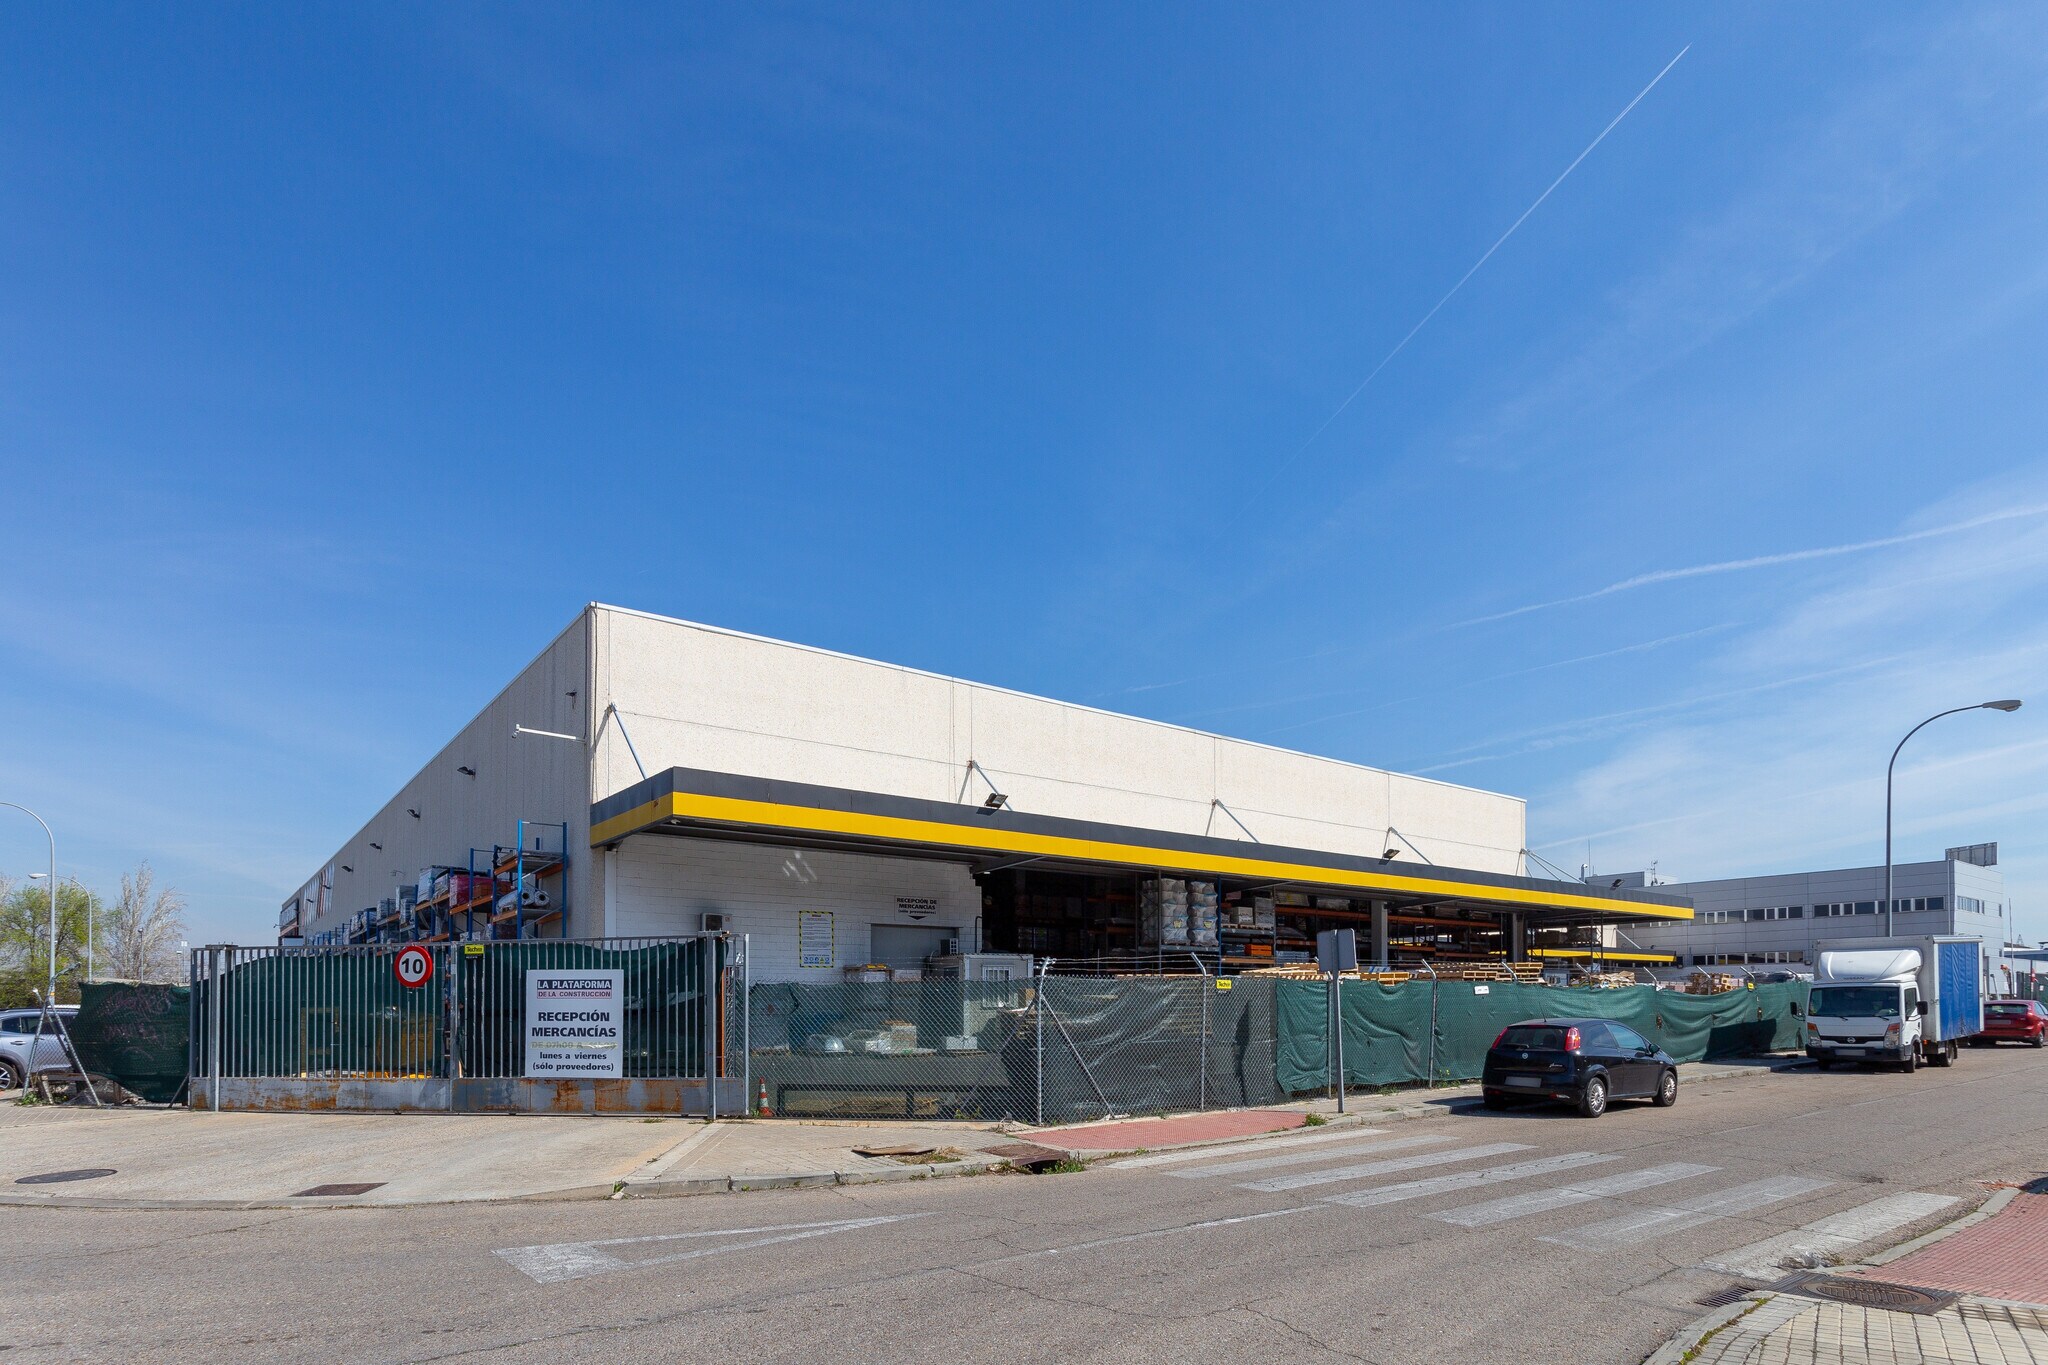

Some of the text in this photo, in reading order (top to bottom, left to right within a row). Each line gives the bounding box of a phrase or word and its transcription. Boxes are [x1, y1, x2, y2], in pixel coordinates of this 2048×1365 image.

[401, 958, 423, 974] 10
[537, 981, 611, 989] LA PLATAFORMA
[538, 1009, 610, 1022] RECEPCIÓN
[531, 1025, 617, 1037] MERCANCÍAS
[540, 1051, 562, 1060] lunes
[574, 1051, 607, 1060] viernes
[532, 1062, 614, 1071] (sólo proveedores)
